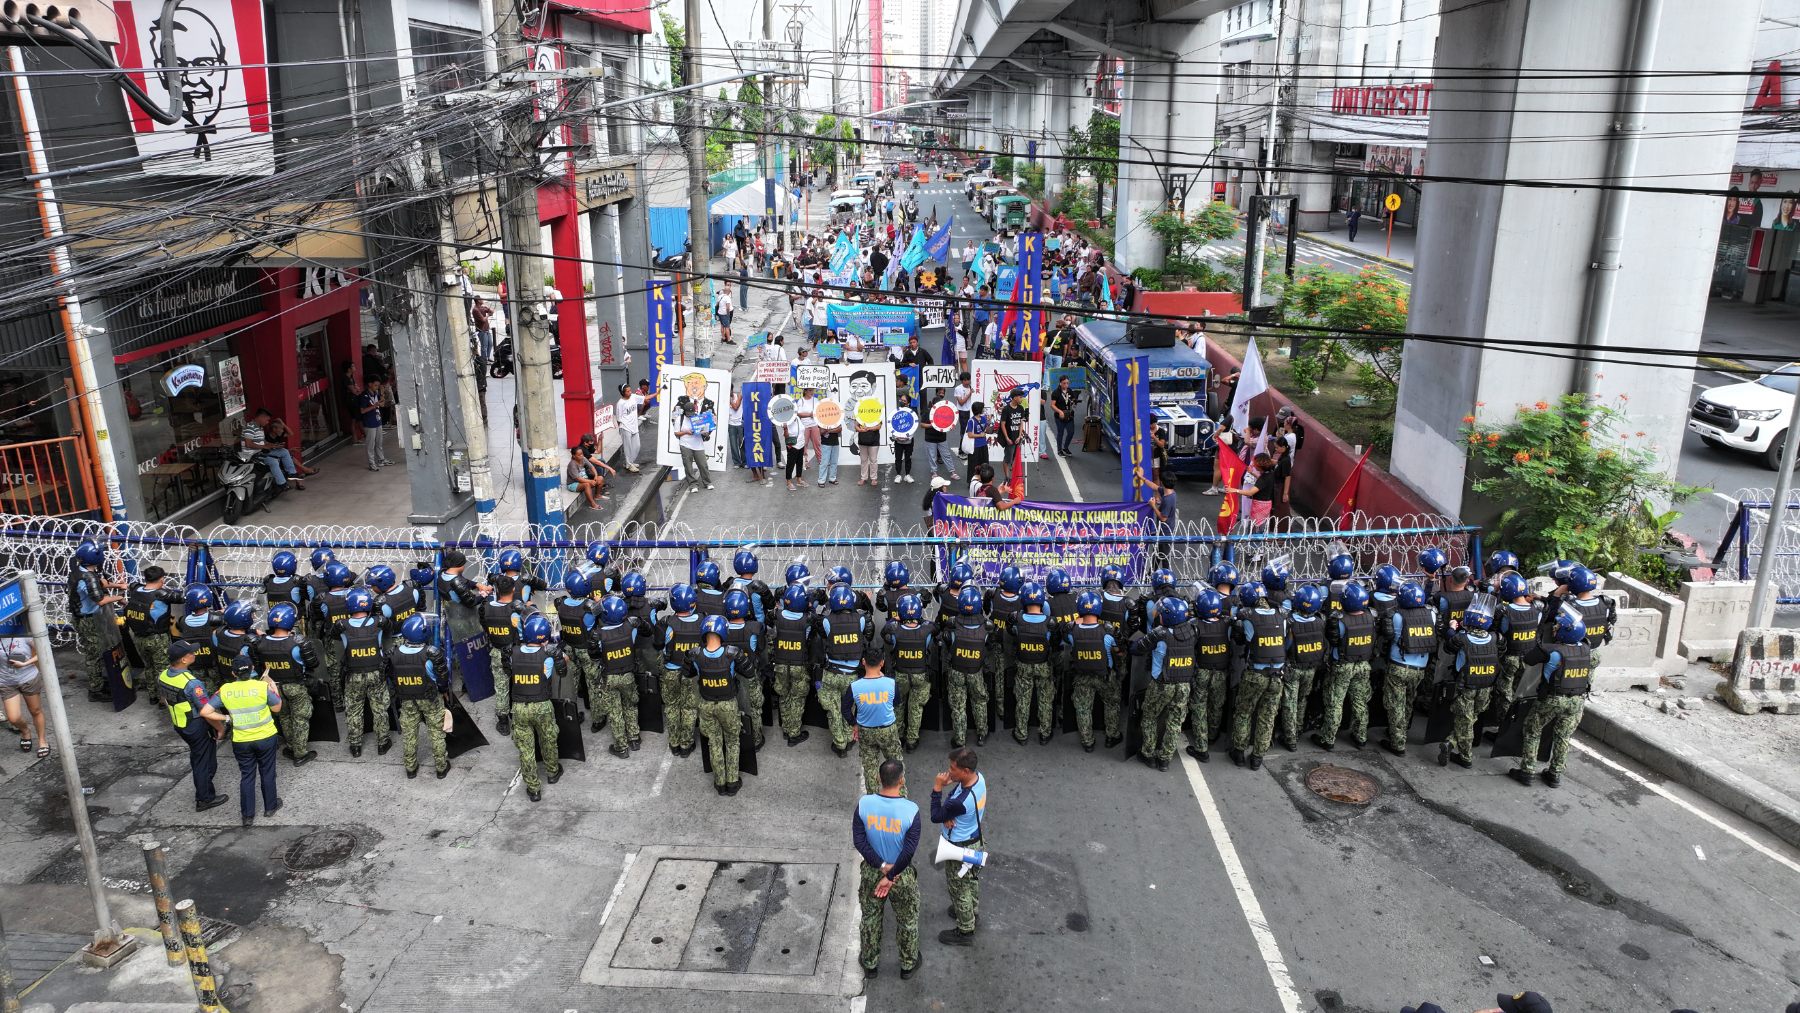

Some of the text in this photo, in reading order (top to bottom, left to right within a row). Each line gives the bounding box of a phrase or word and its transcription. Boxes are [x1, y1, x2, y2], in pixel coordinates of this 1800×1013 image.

[303, 267, 353, 299] KFC
[1020, 236, 1035, 351] KILUSAN
[155, 288, 187, 318] finger
[751, 391, 764, 463] KILUSAN
[137, 456, 158, 476] KFC
[2, 473, 35, 485] KFC
[946, 503, 1013, 521] MAMAMAYAN
[1071, 511, 1084, 523] AT
[128, 611, 144, 620] PULIS
[489, 627, 509, 635] PULIS
[564, 626, 581, 634] PULIS
[1410, 628, 1432, 636] PULIS
[835, 635, 857, 644] PULIS
[1513, 631, 1536, 640] PULIS
[779, 641, 800, 650] PULIS
[1259, 637, 1283, 646] PULIS
[1202, 645, 1225, 653] PULIS
[1298, 642, 1322, 652] PULIS
[608, 648, 630, 659] PULIS
[900, 651, 922, 659] PULIS
[957, 649, 980, 658] PULIS
[1170, 658, 1192, 667] PULIS
[1470, 666, 1495, 674] PULIS
[1566, 669, 1587, 677] PULIS
[516, 675, 539, 684] PULIS
[704, 679, 728, 687] PULIS
[226, 688, 258, 699] PULIS
[860, 691, 889, 705] PULIS
[867, 815, 901, 833] PULIS
